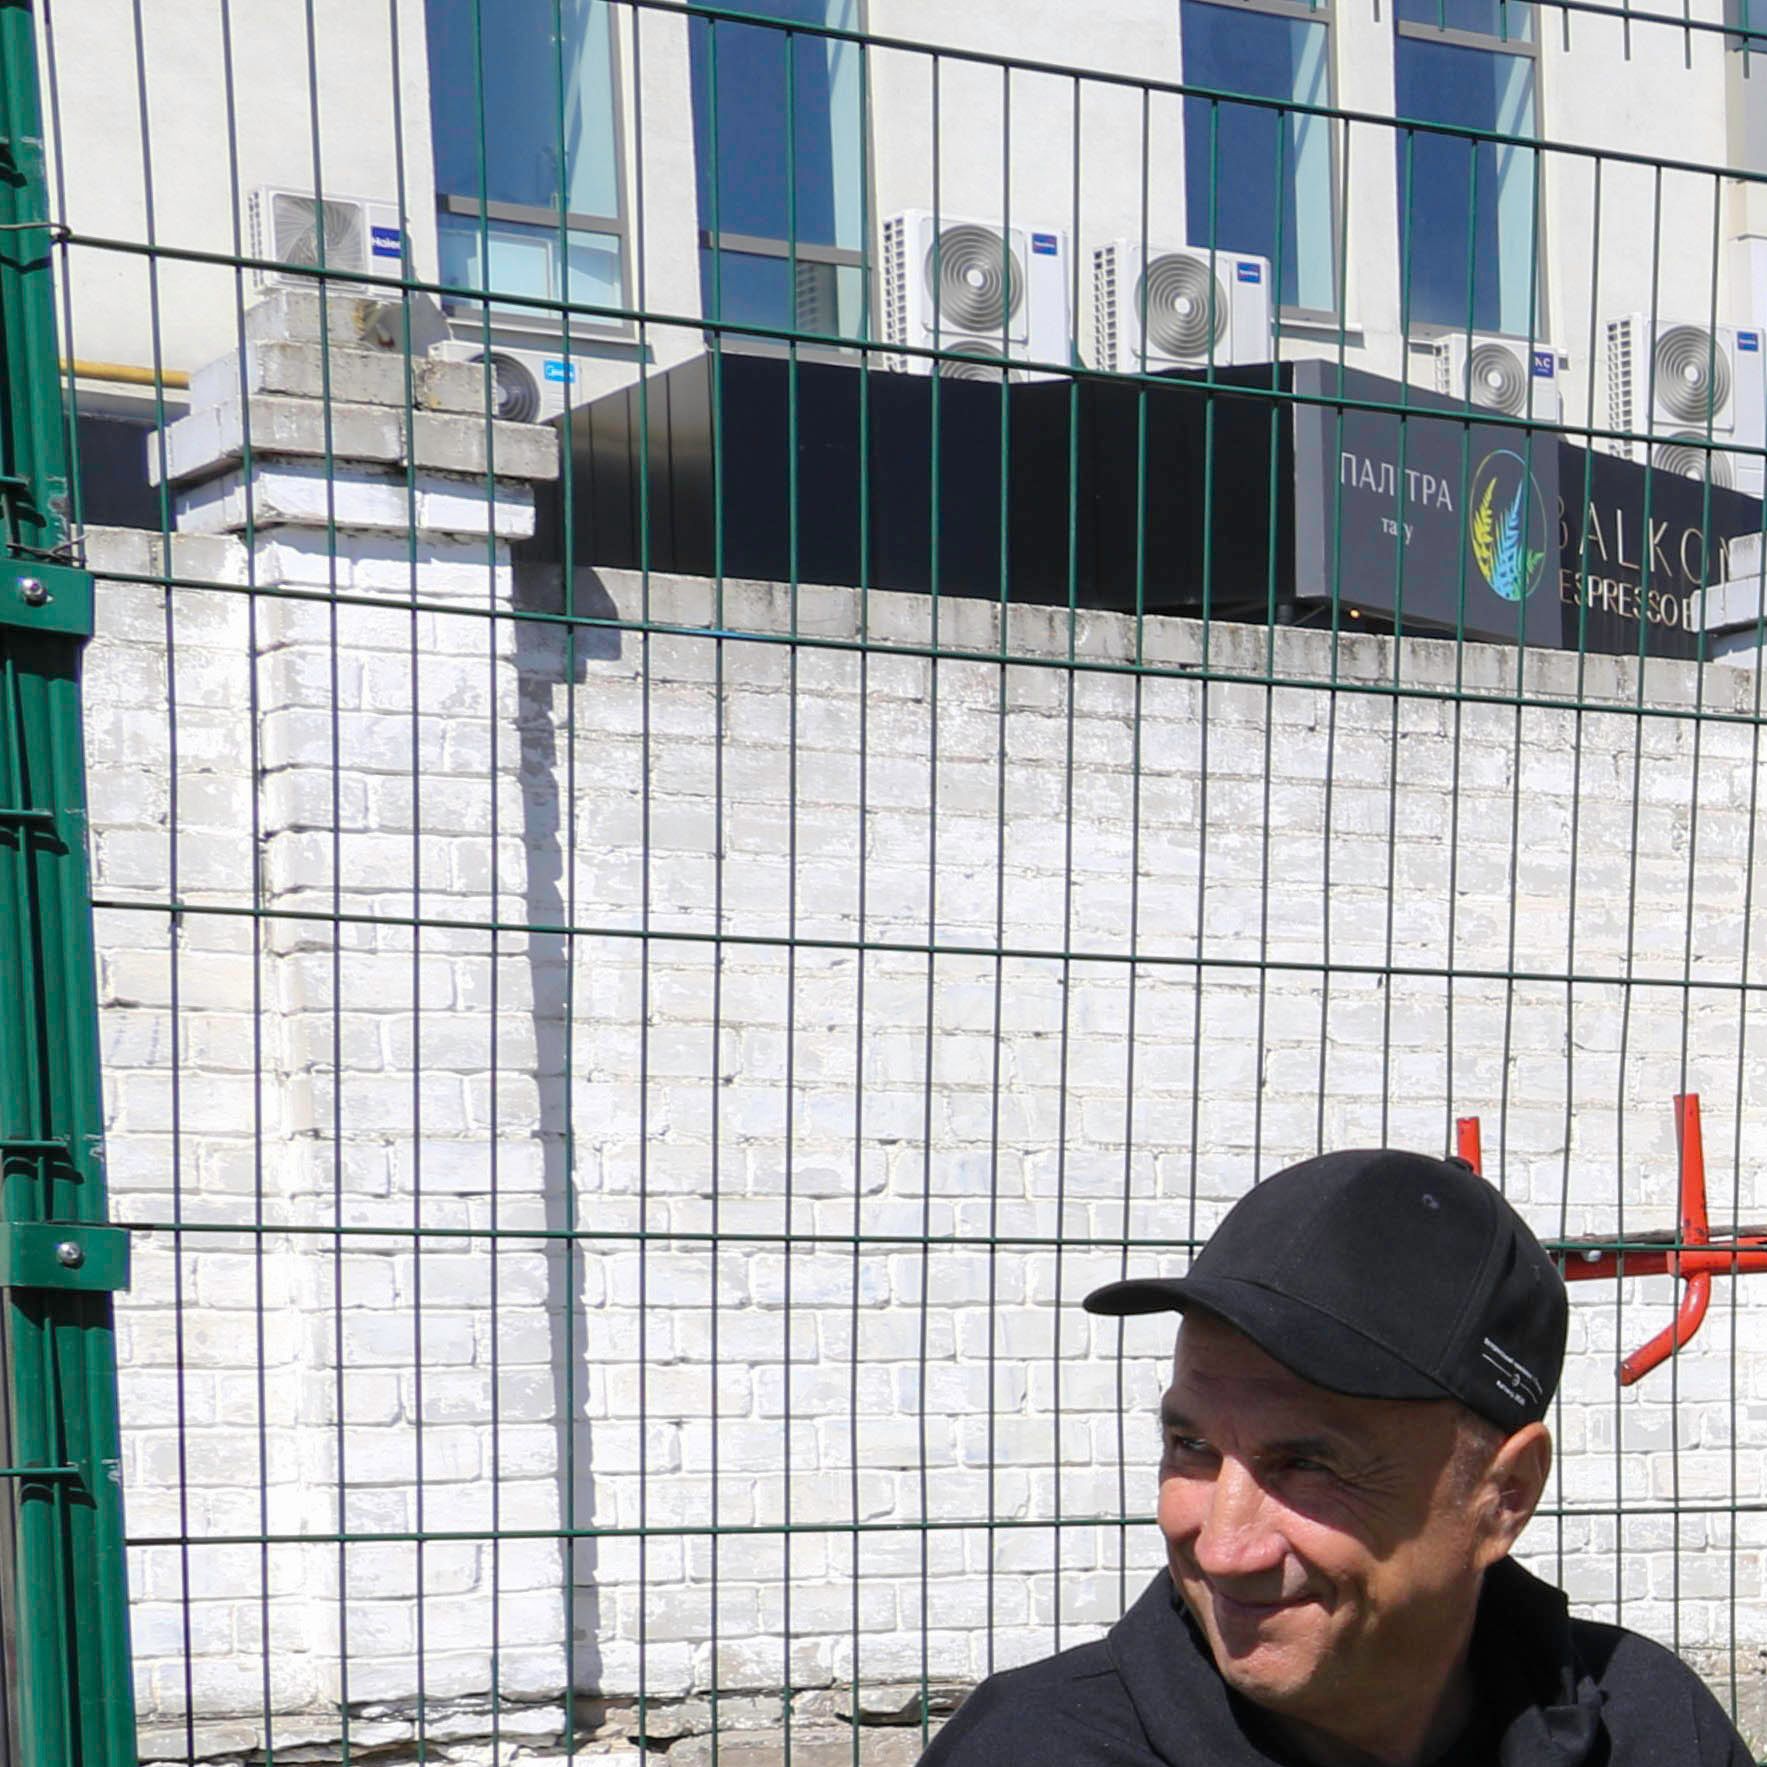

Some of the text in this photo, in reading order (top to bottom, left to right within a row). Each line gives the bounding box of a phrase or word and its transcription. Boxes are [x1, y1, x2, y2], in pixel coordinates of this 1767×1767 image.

[1340, 451, 1454, 512] ПАЛТРА
[1381, 516, 1415, 546] тау
[1560, 568, 1679, 627] ESPRESSO
